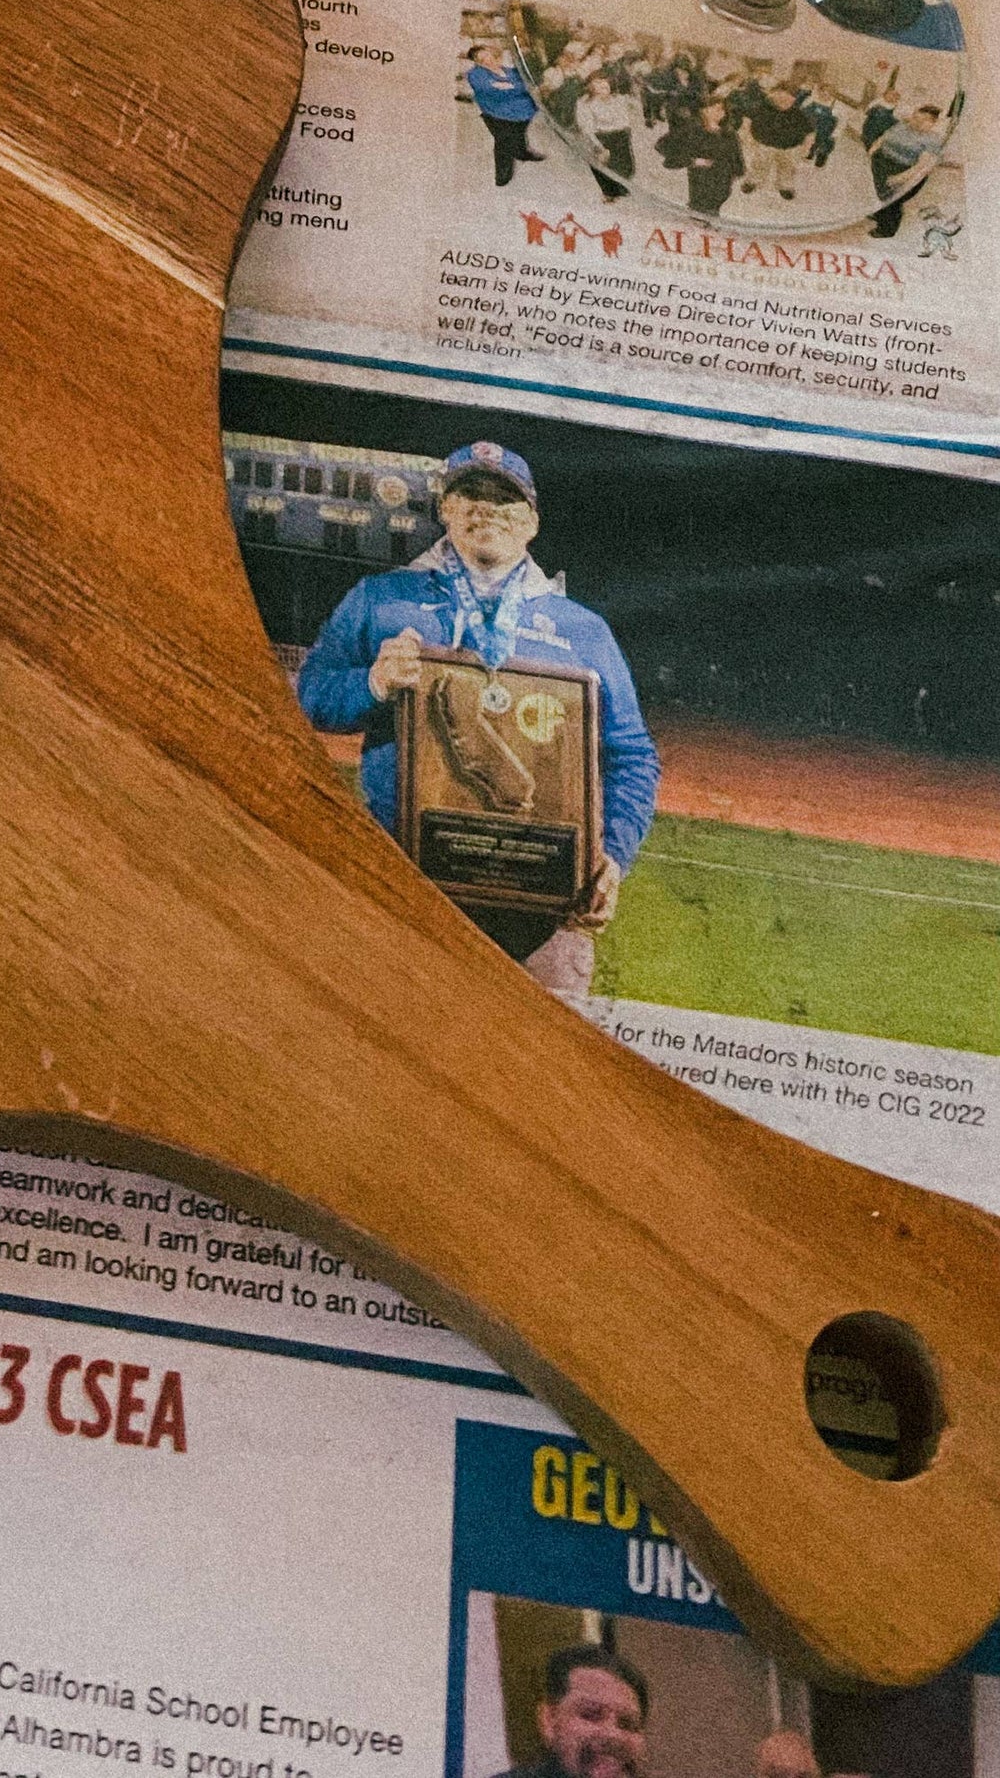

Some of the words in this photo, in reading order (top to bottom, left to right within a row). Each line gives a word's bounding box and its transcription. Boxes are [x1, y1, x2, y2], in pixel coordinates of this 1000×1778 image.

[315, 39, 395, 64] develop
[300, 122, 355, 142] Food
[290, 213, 349, 231] menu
[645, 228, 903, 284] ALHAMBRA
[439, 249, 515, 276] AUSD's
[519, 260, 661, 297] award-winning
[667, 282, 716, 305] Food
[722, 292, 758, 312] and
[764, 299, 864, 327] Nutritional
[869, 312, 952, 338] Services
[439, 273, 488, 291] team
[493, 276, 509, 293] is
[514, 279, 546, 298] led
[550, 285, 573, 306] by
[579, 288, 671, 318] Executive
[677, 304, 756, 330] Director
[762, 318, 816, 340] Vivien
[823, 325, 878, 350] Watts
[885, 333, 942, 357] (front-
[437, 293, 510, 317] center),
[517, 304, 557, 322] who
[563, 312, 617, 332] notes
[622, 318, 654, 338] the
[658, 322, 770, 354] importance
[776, 337, 798, 356] of
[801, 343, 879, 372] keeping
[885, 356, 967, 382] students
[437, 316, 475, 333] well
[479, 322, 516, 342] fed,
[589, 333, 604, 351] is
[609, 340, 623, 355] a
[628, 341, 694, 366] source
[699, 349, 721, 368] of
[724, 356, 806, 383] comfort,
[812, 367, 894, 397] security,
[901, 380, 939, 400] and
[615, 1022, 646, 1044] for
[651, 1028, 685, 1051] the
[693, 1033, 798, 1068] Matadors
[804, 1051, 887, 1082] historic
[893, 1067, 974, 1095] season
[724, 1069, 774, 1095] here
[780, 1079, 828, 1103] with
[835, 1086, 870, 1109] the
[878, 1091, 921, 1117] CIG
[928, 1100, 987, 1127] 2022
[122, 1185, 171, 1214] and
[36, 1246, 77, 1270] am
[84, 1249, 177, 1293] looking
[185, 1267, 285, 1304] forward
[292, 1282, 317, 1308] to
[325, 1294, 357, 1316] an
[158, 1231, 198, 1254] am
[205, 1235, 302, 1272] grateful
[308, 1248, 345, 1277] for
[44, 1352, 189, 1456] CSEA
[530, 1443, 670, 1536] GEO
[626, 1537, 729, 1609] UNS
[145, 1685, 249, 1731] School
[259, 1704, 405, 1757] Employee
[152, 1737, 176, 1769] is
